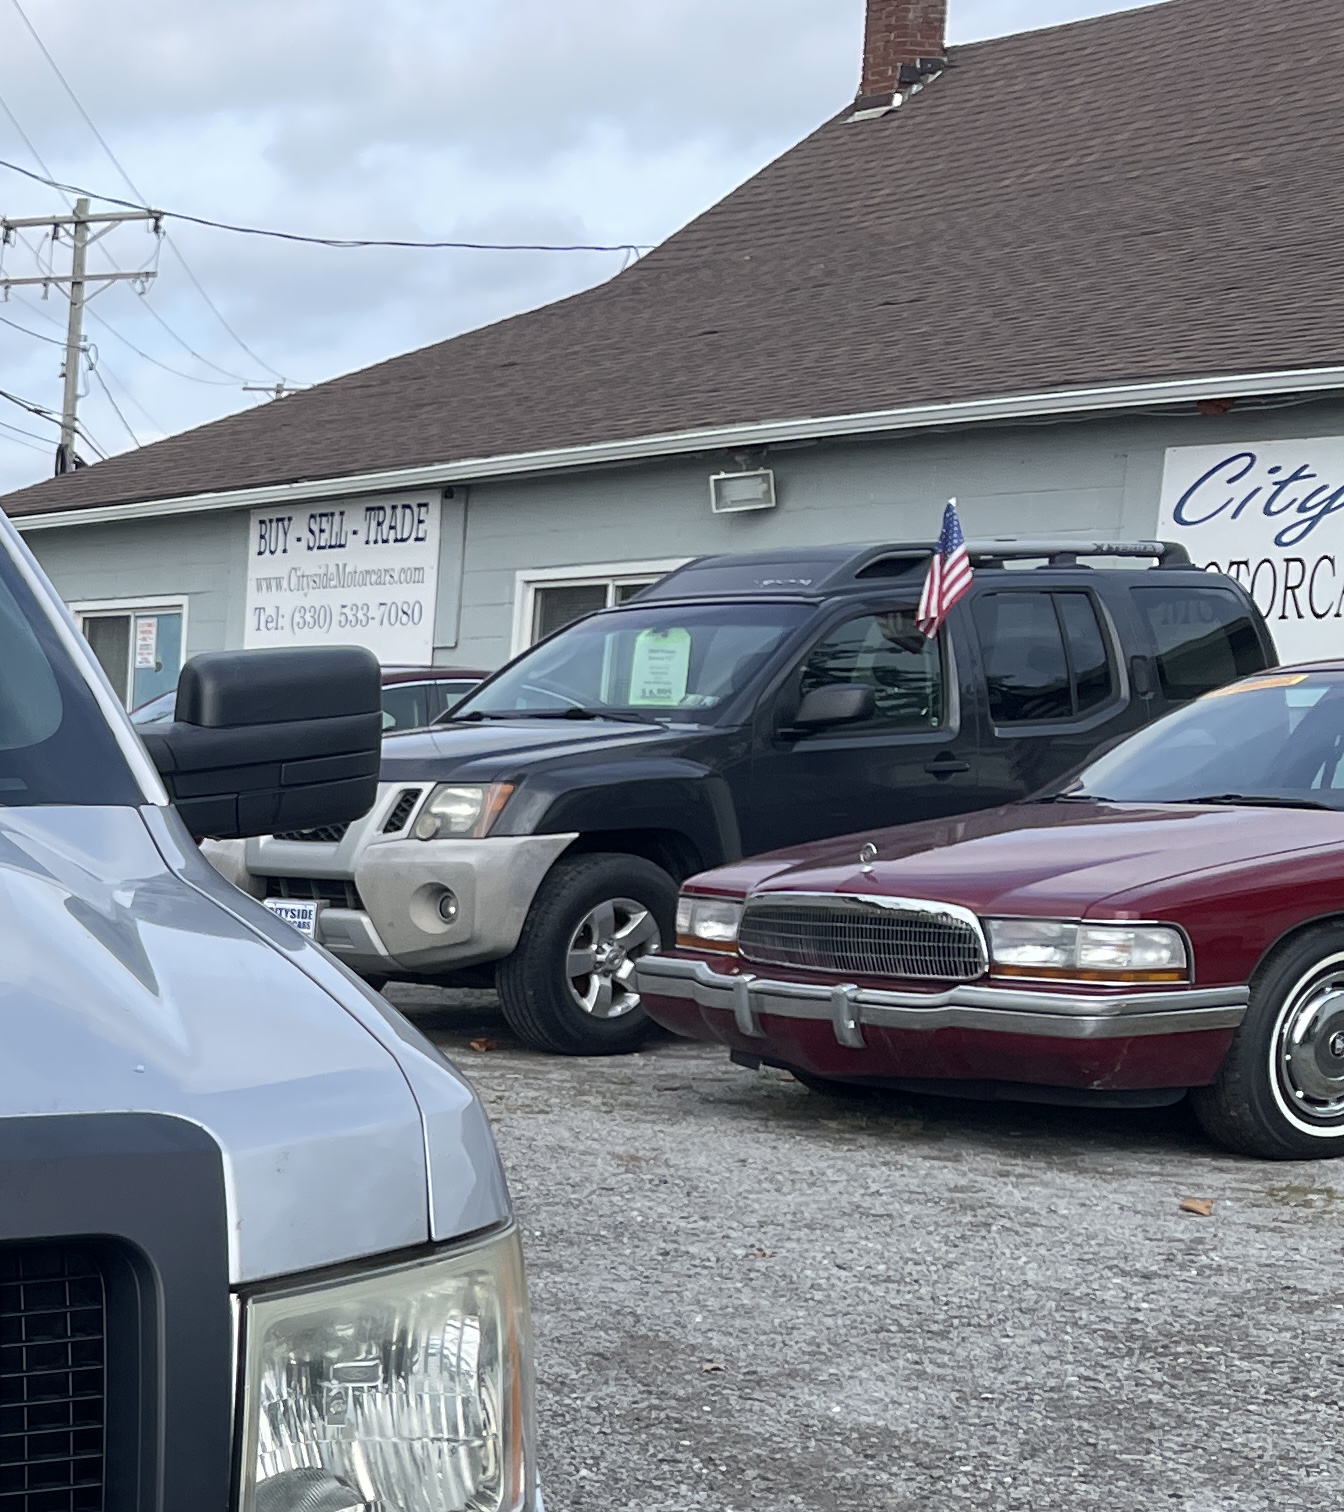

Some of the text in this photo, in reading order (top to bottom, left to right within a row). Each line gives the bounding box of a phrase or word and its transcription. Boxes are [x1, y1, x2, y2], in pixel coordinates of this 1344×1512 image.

[257, 516, 293, 556] BUY
[307, 510, 348, 552] SELL
[365, 502, 430, 545] TRADE
[256, 562, 425, 597] www.CitysideMotorcars.com
[254, 600, 424, 635] Tel: (330) 533-7080
